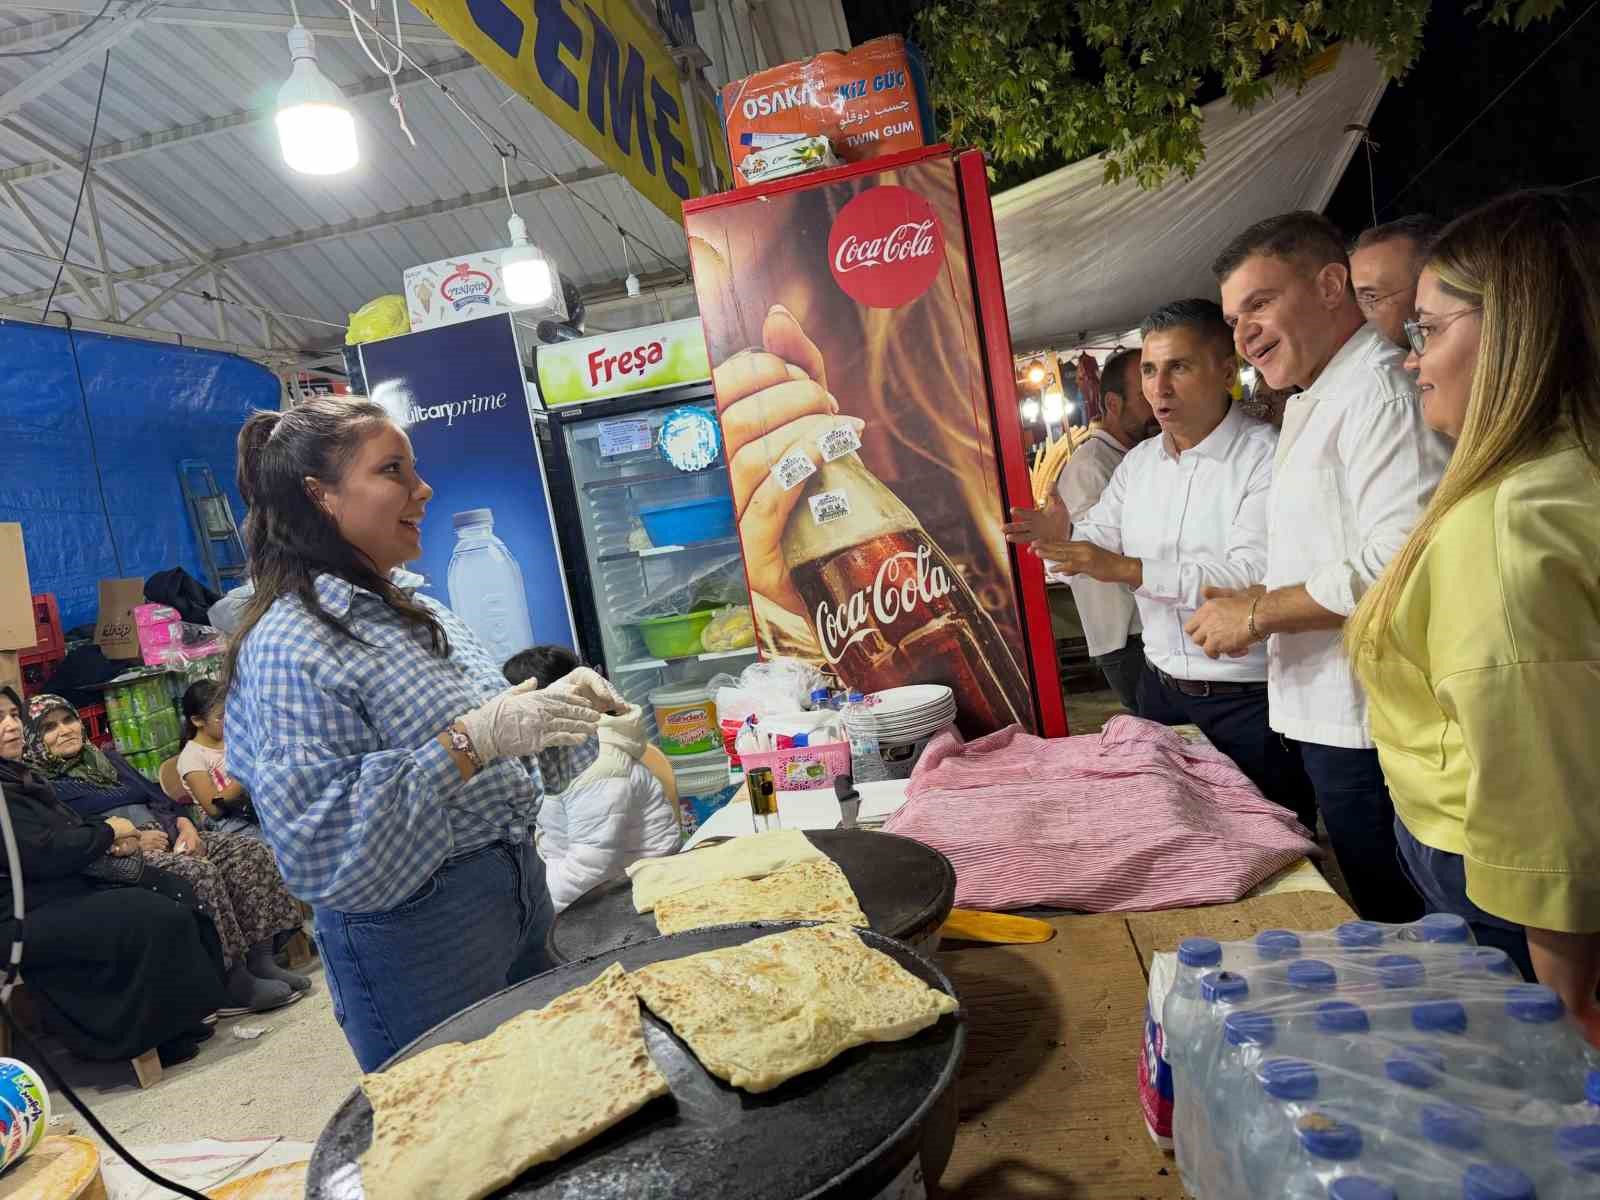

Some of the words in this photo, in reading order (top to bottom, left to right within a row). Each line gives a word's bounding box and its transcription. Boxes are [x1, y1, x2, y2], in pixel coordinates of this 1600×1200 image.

[847, 129, 880, 148] TWIN
[883, 120, 914, 137] GUM
[835, 219, 935, 273] Coca-Cola
[587, 341, 663, 387] Freşa
[816, 544, 951, 665] Coca-Cola
